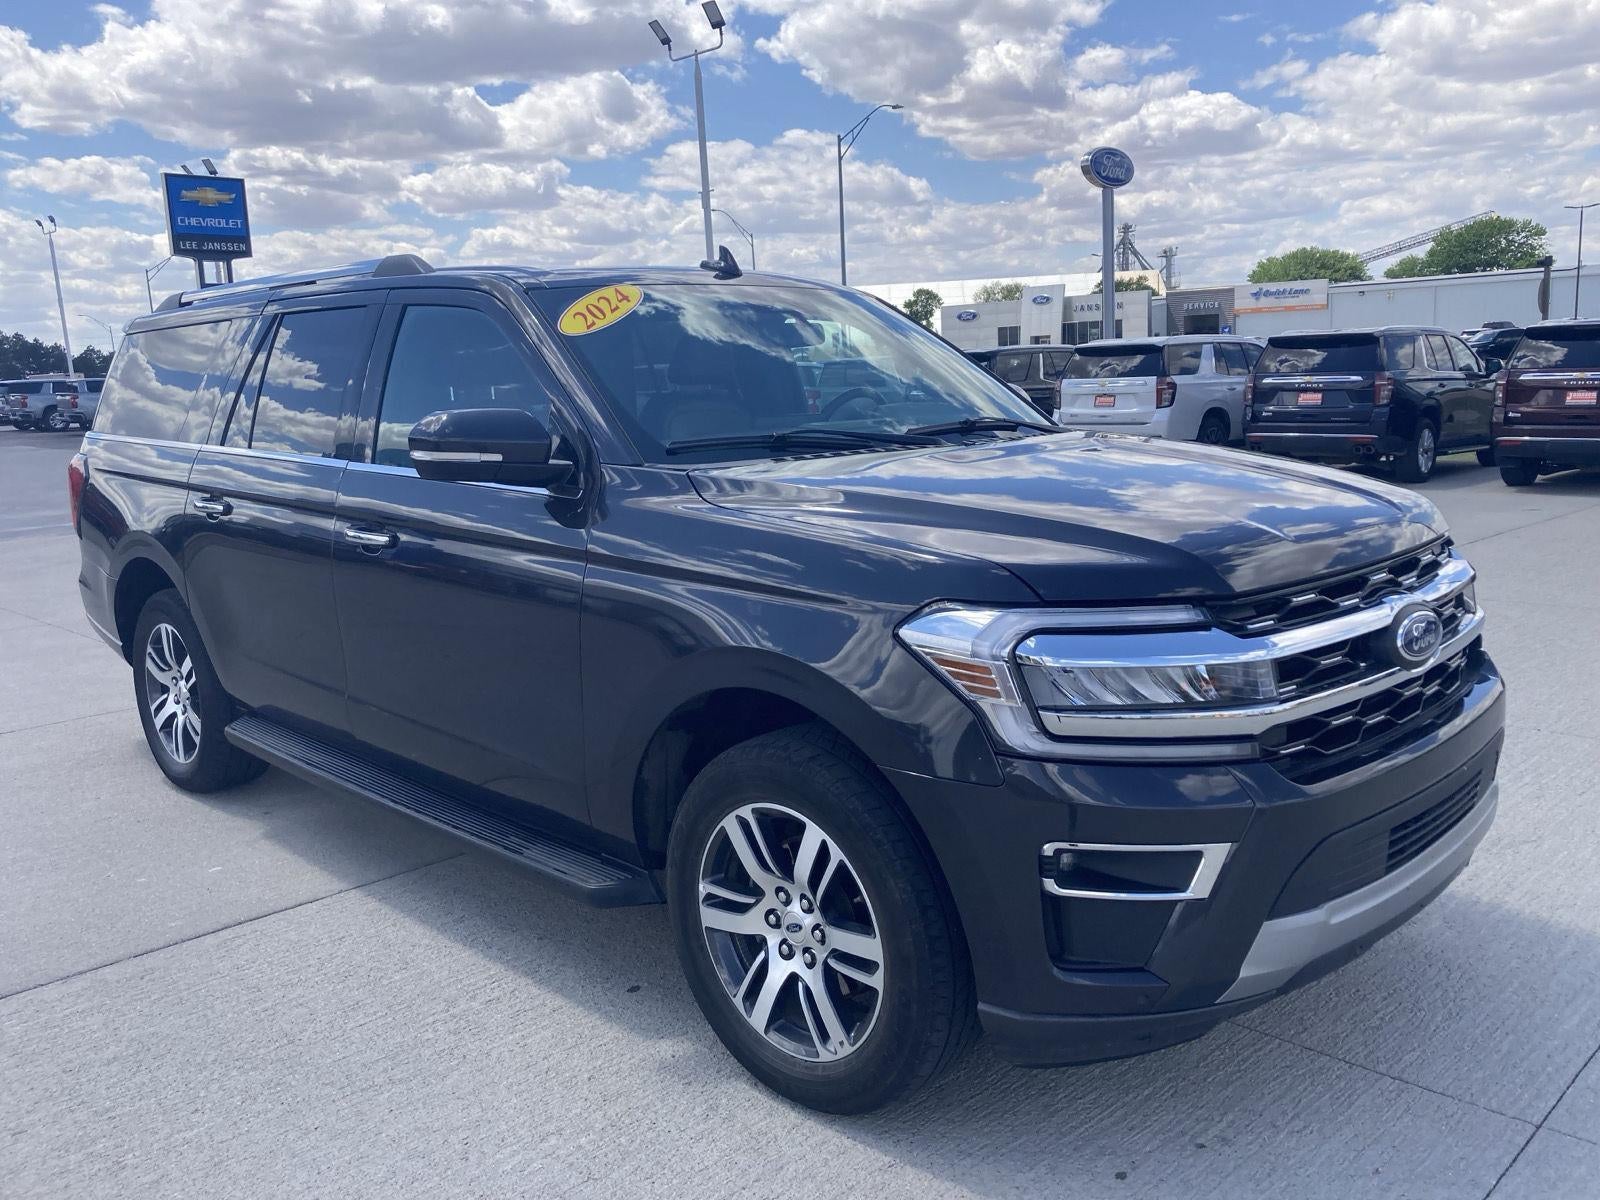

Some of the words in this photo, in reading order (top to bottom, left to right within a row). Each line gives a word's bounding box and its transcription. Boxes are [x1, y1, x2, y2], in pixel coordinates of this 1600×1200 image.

[1101, 154, 1126, 179] Ford
[177, 216, 243, 229] CHEVROLET
[180, 241, 199, 250] LEE
[202, 242, 246, 251] JANSSEN
[1262, 287, 1287, 297] Quick
[1288, 287, 1311, 295] Lane
[573, 287, 631, 330] 2024
[1073, 301, 1123, 313] JANSN
[1183, 301, 1220, 310] SERVICE
[1412, 620, 1436, 651] Ford
